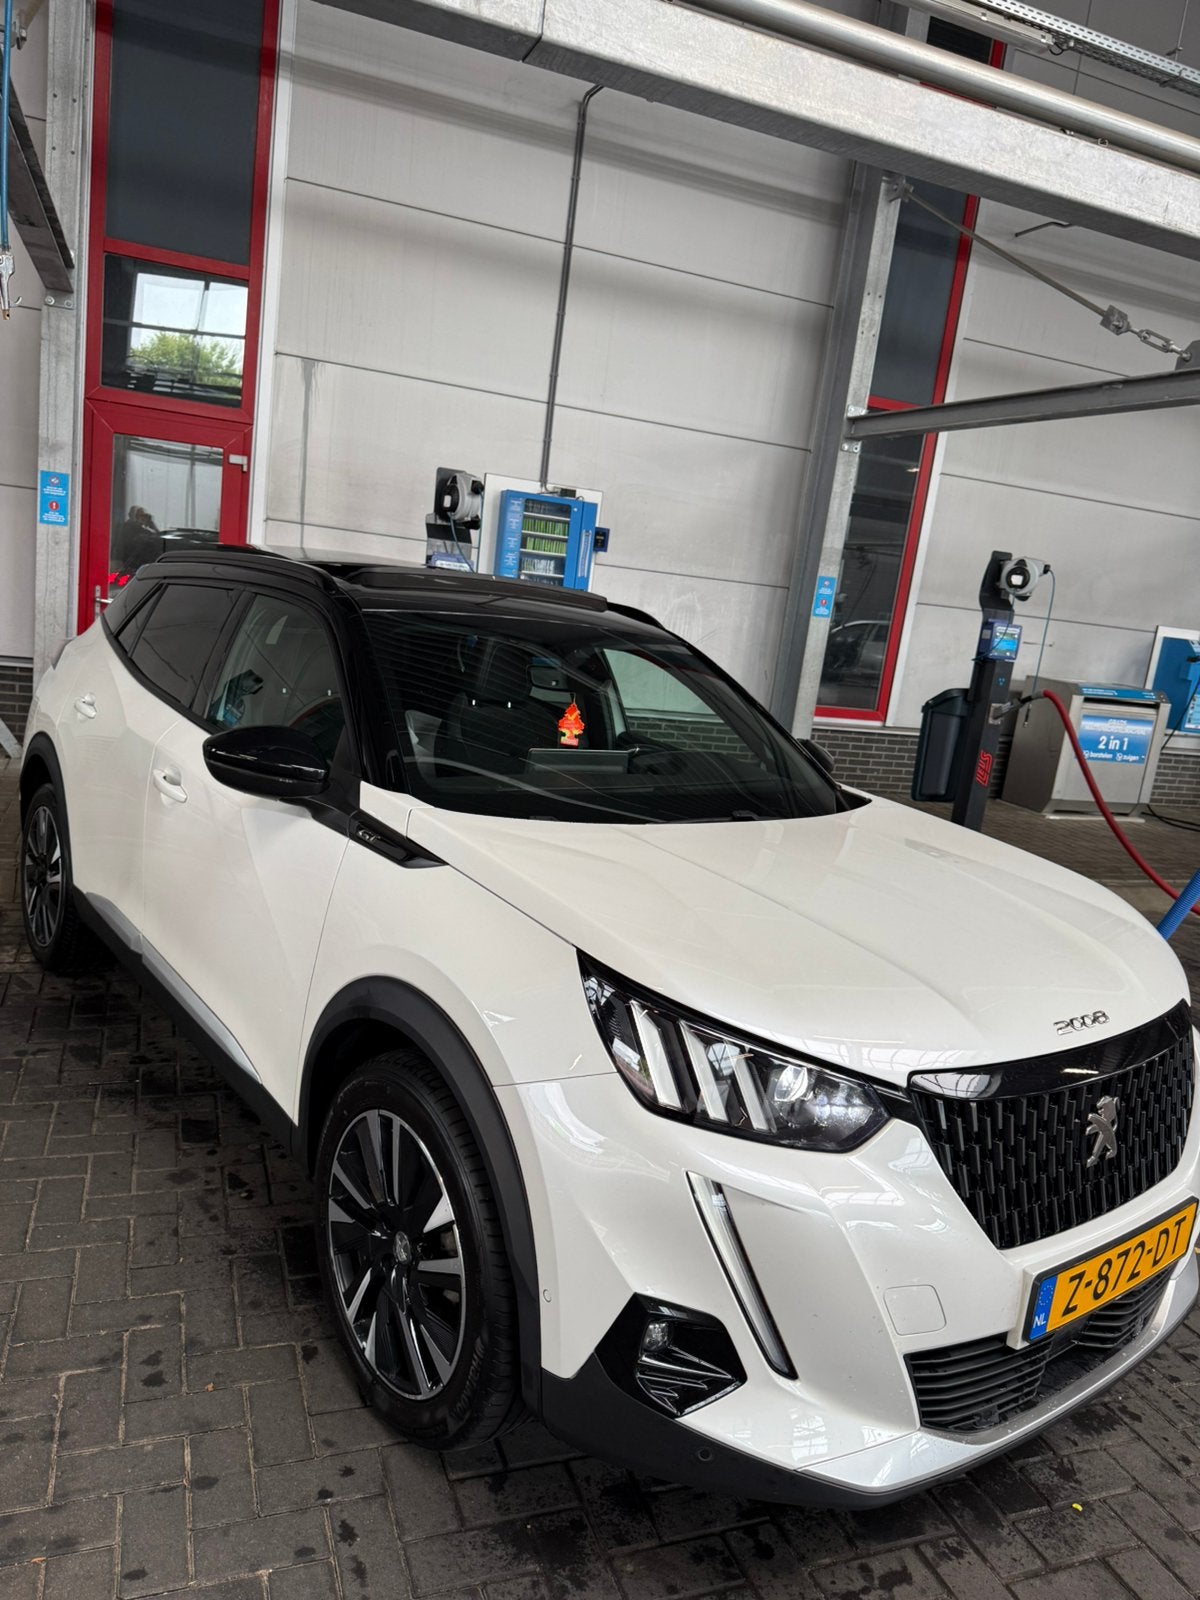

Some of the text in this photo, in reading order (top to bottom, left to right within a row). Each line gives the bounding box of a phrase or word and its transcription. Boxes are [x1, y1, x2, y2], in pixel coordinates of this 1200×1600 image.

[1098, 735, 1129, 751] 2 in 1
[1053, 1010, 1110, 1036] 2008
[1062, 1215, 1187, 1317] Z-872-DT
[1033, 1312, 1047, 1329] NL
